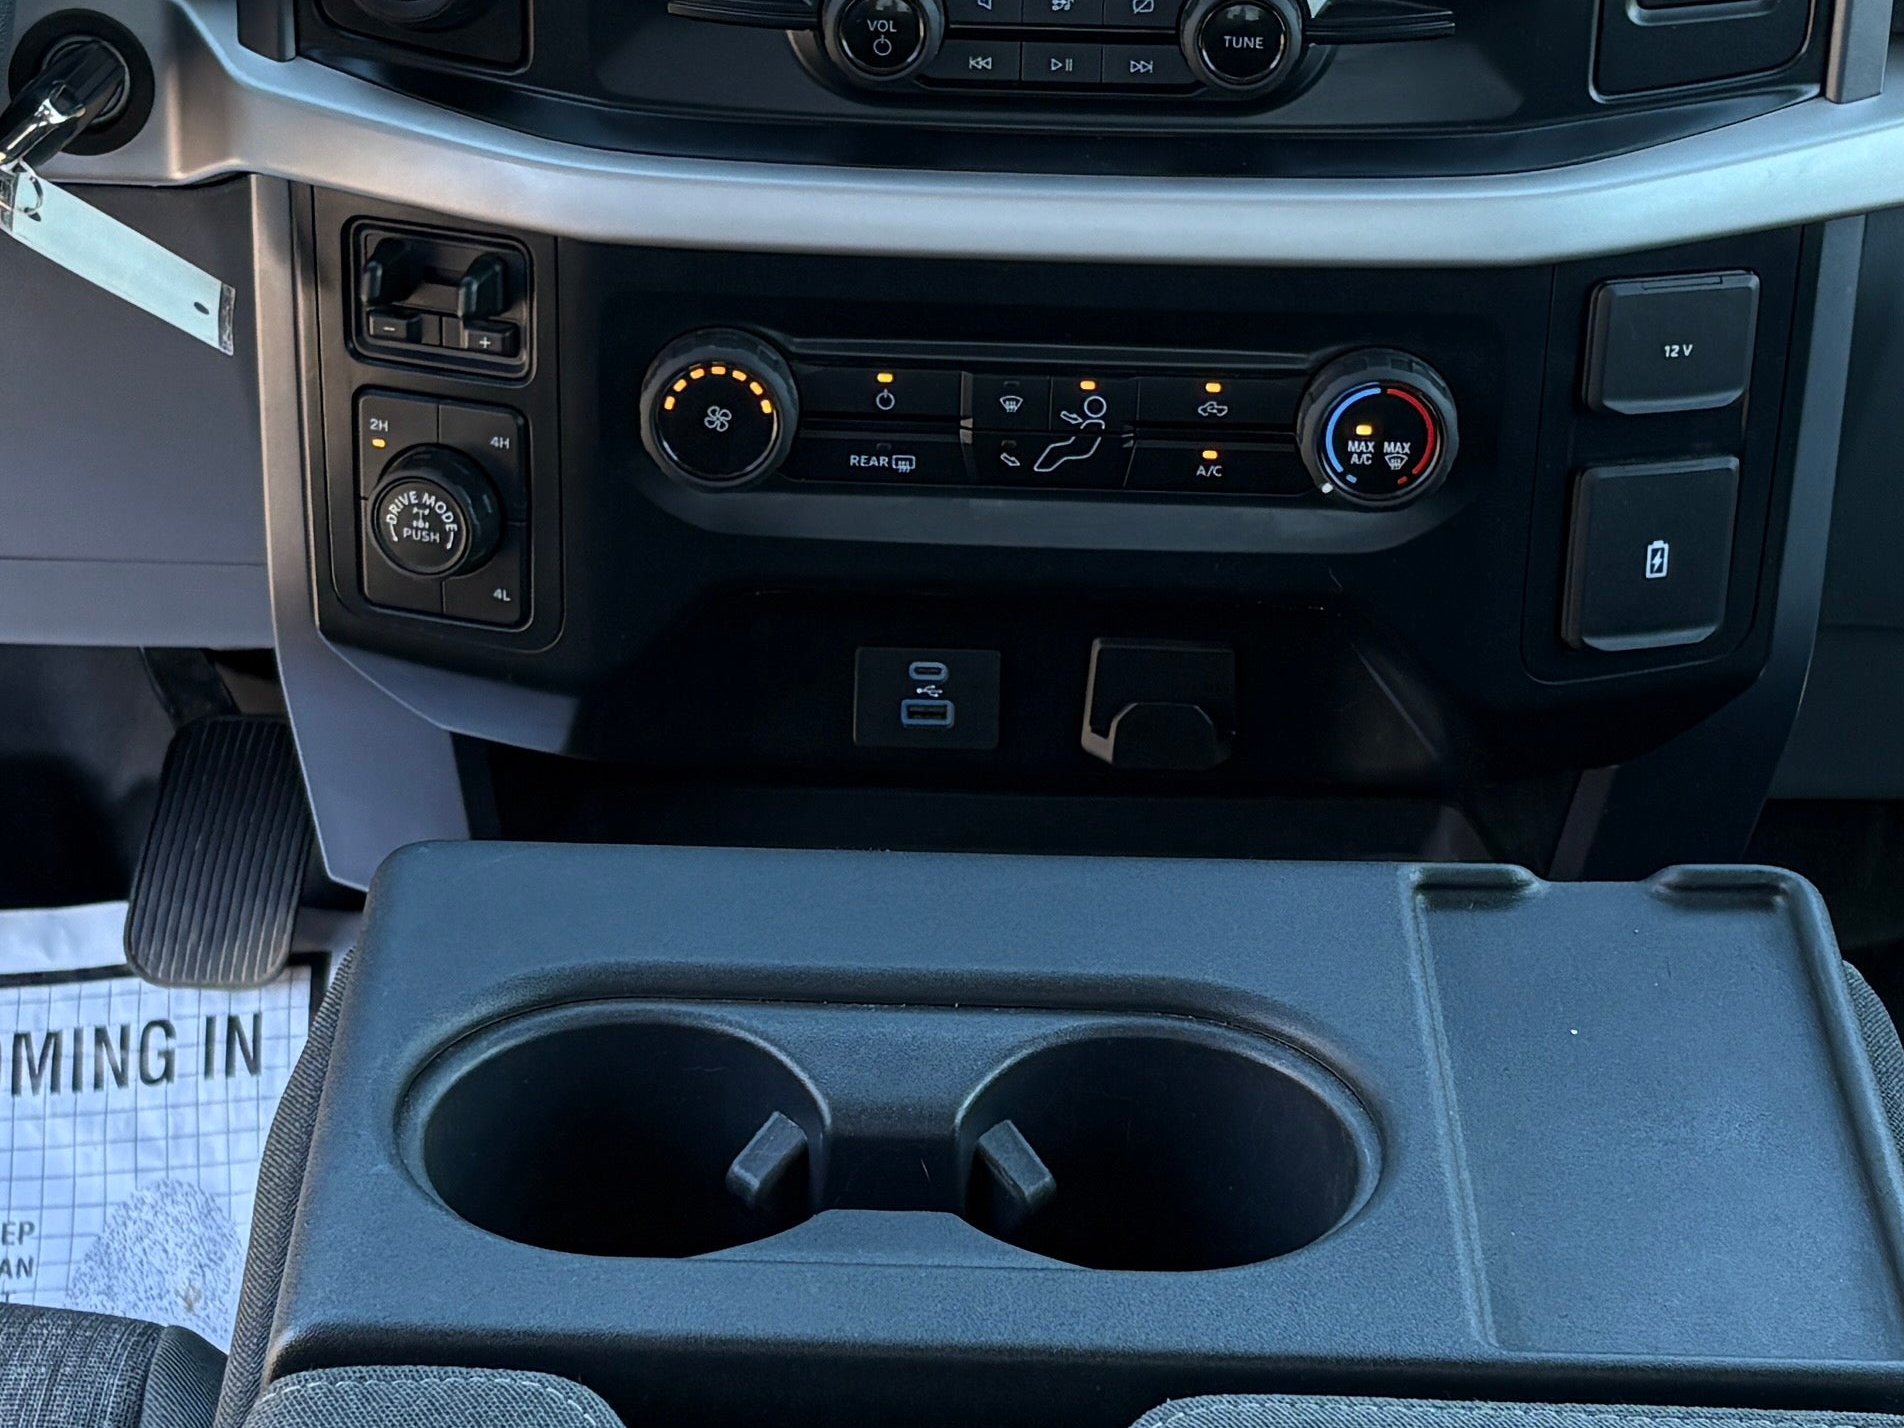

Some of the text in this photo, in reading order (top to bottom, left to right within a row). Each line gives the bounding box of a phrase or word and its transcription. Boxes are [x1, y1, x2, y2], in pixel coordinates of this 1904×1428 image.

[866, 19, 897, 33] VOL
[1223, 35, 1266, 50] TUNE
[369, 418, 390, 433] 2H
[490, 436, 511, 450] 4H
[1347, 440, 1375, 453] MAX
[1383, 441, 1411, 454] MAX
[849, 454, 889, 469] REAR
[1350, 453, 1372, 465] A/C
[1196, 464, 1223, 478] A/C
[385, 489, 459, 533] DRIVE MODE
[402, 527, 441, 544] PUSH
[493, 587, 512, 602] 4L
[202, 1011, 264, 1081] IN
